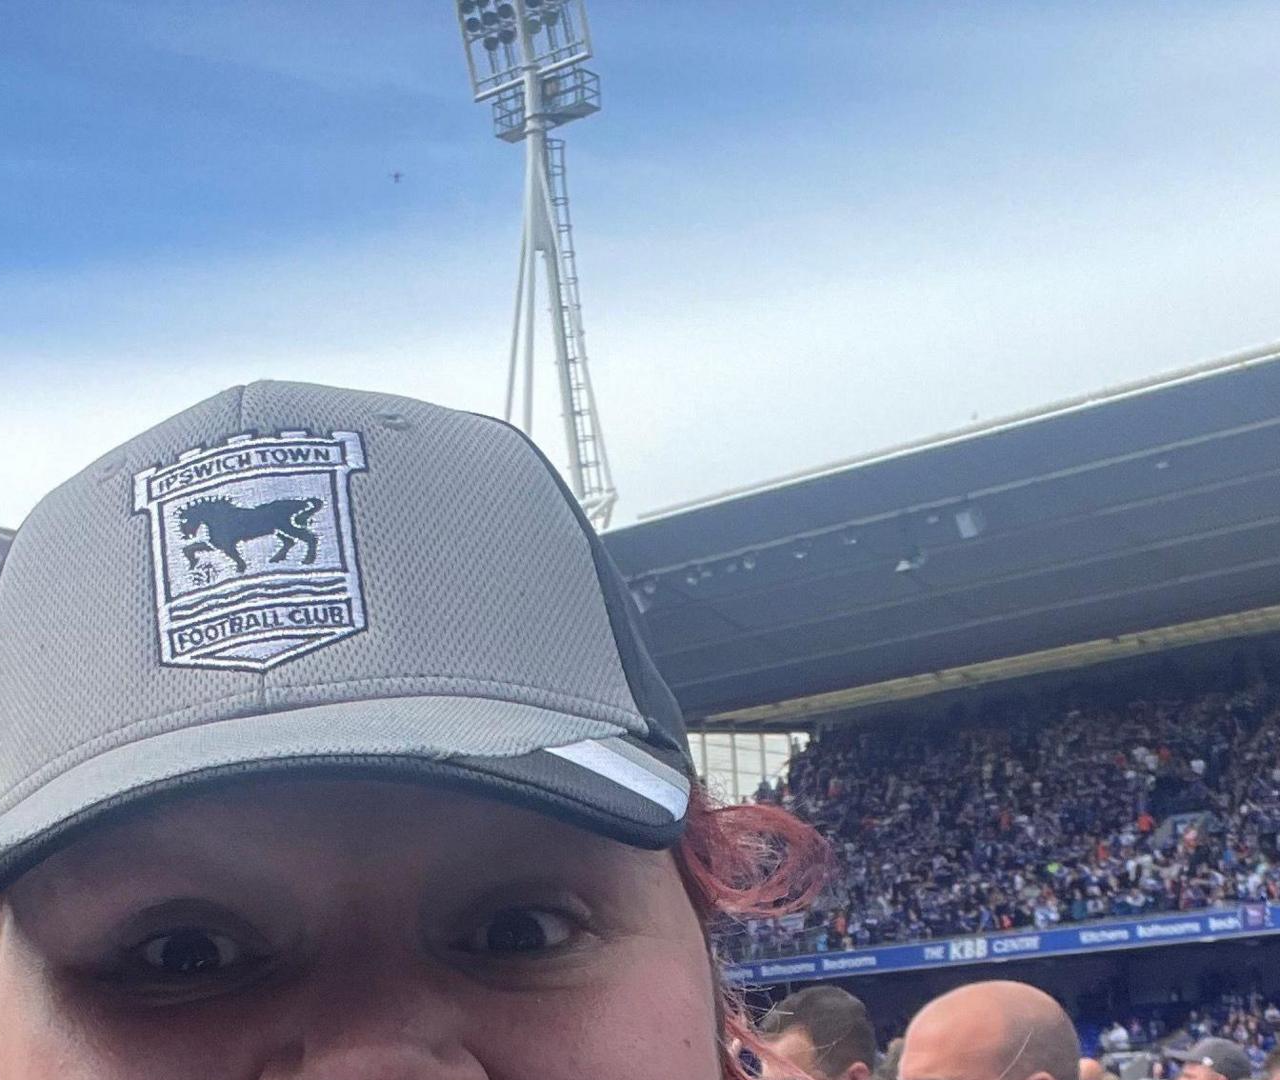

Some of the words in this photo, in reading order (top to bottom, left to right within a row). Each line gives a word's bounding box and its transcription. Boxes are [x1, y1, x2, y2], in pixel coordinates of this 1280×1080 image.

[158, 454, 252, 493] IPSWICH
[253, 448, 330, 465] TOWN
[178, 613, 282, 651] FOOTBALL
[288, 605, 345, 625] CLUB
[949, 938, 987, 960] KBB
